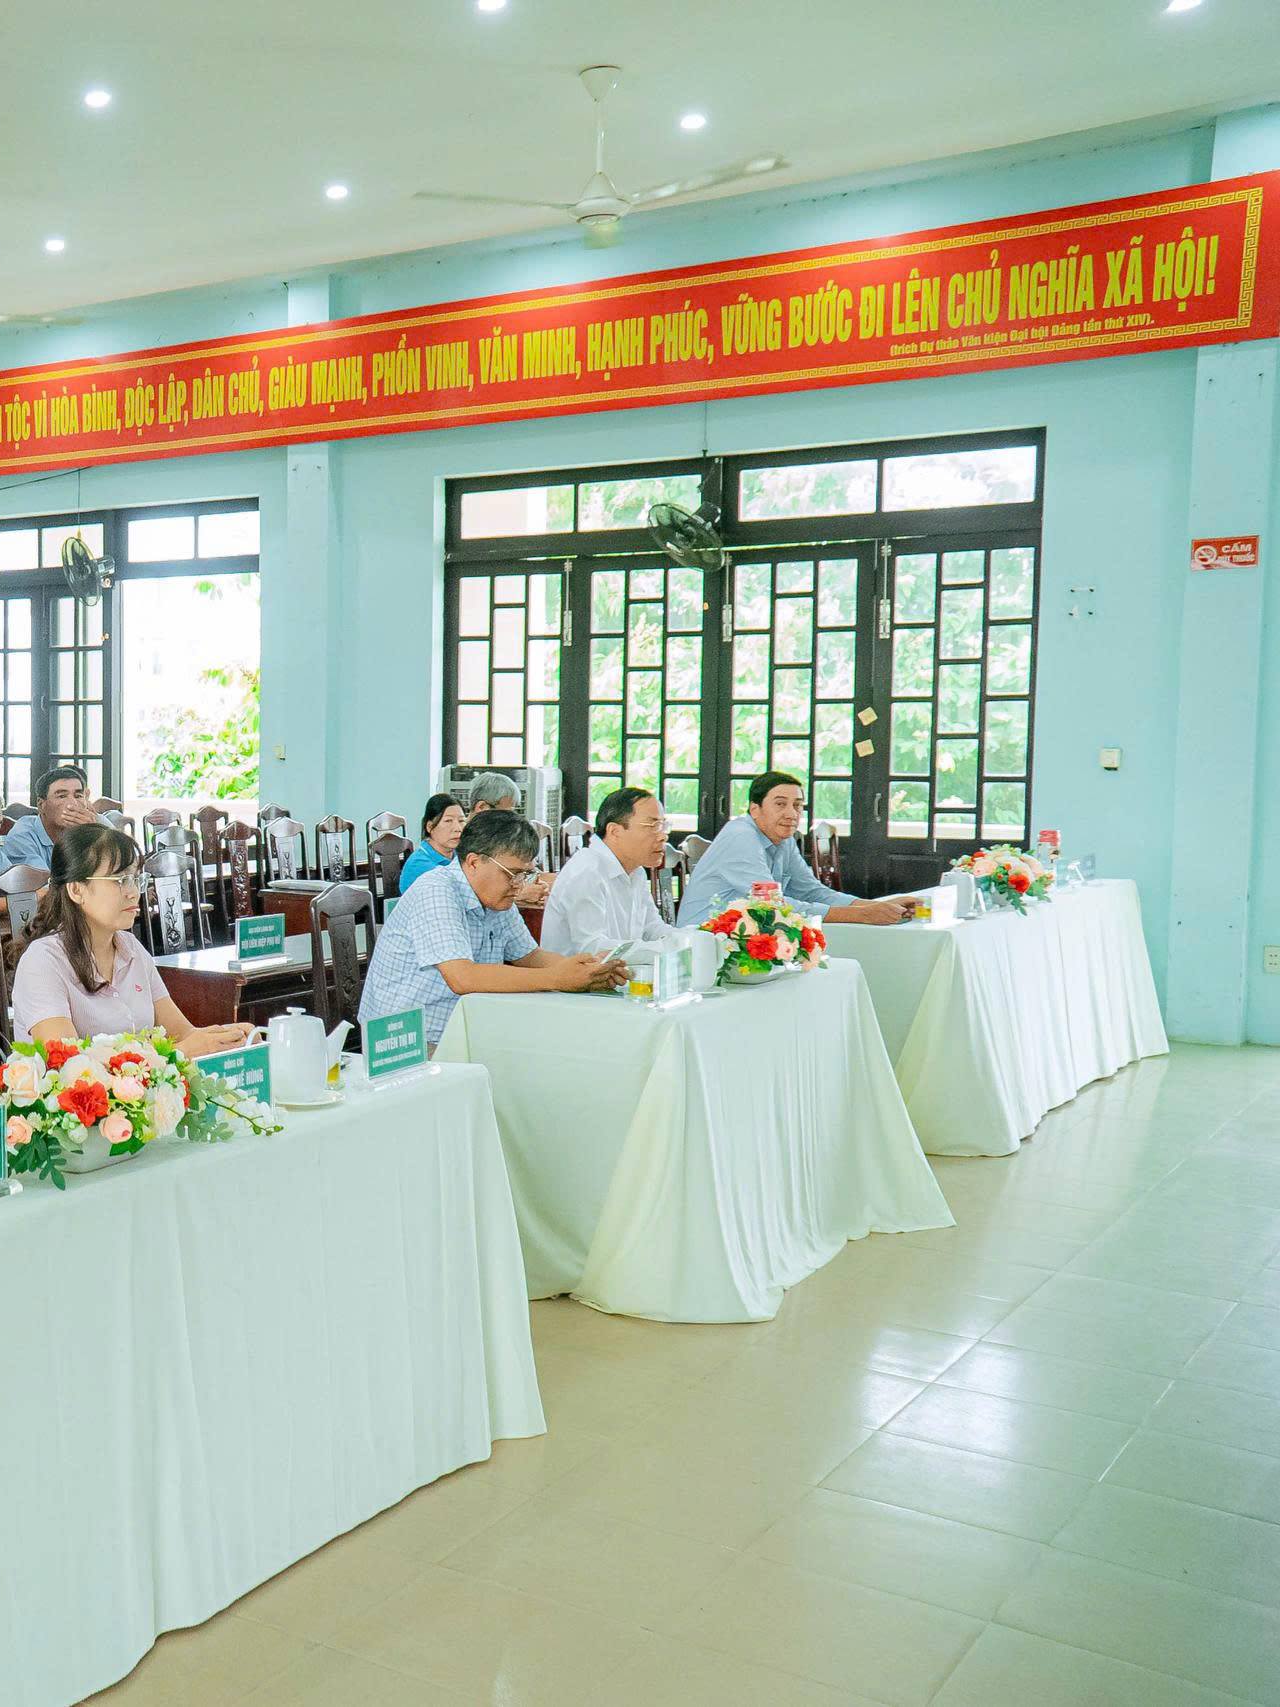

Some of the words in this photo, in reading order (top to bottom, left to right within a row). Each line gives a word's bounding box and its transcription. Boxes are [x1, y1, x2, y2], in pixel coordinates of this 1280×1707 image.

[5, 394, 30, 450] TỘC
[34, 390, 48, 439] VÌ
[51, 386, 79, 437] HÒA
[82, 383, 121, 435] BÌNH,
[125, 377, 154, 436] ĐỘC
[158, 373, 188, 432] LẬP,
[192, 367, 224, 420] DÂN
[228, 355, 263, 417] CHỦ,
[269, 355, 307, 411] GIÀU
[311, 355, 367, 413] MẠNH,
[372, 333, 420, 397] PHỒN
[425, 340, 473, 392] VINH,
[479, 326, 518, 385] VĂN
[523, 326, 582, 380] MINH,
[587, 316, 644, 381] HẠNH
[650, 300, 714, 365] PHÚC,
[721, 293, 782, 356] VỮNG
[788, 279, 853, 348] BƯỚC
[858, 284, 885, 340] ĐI
[892, 267, 940, 336] LÊN
[947, 248, 1001, 329] CHỦ
[1008, 244, 1095, 321] NGHĨA
[1102, 234, 1144, 309] XÃ
[1152, 225, 1219, 313] HỘI!
